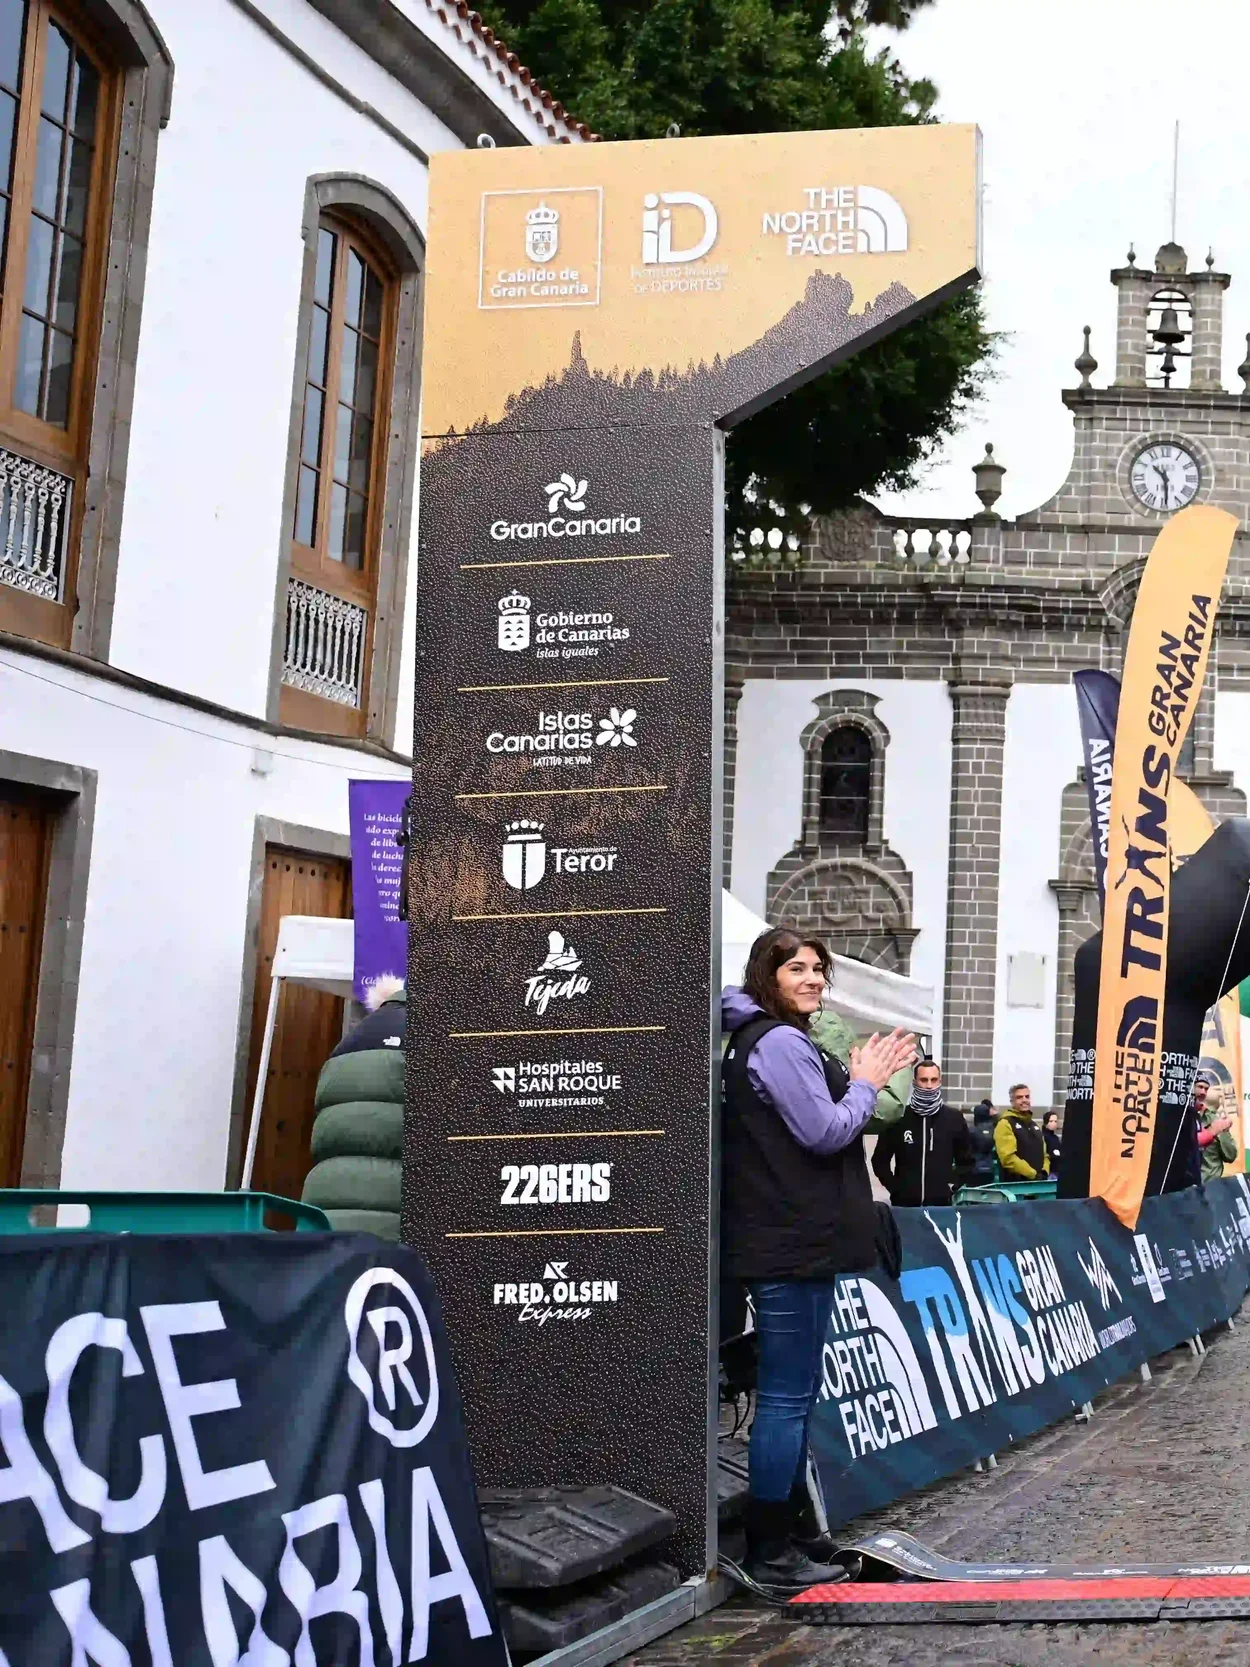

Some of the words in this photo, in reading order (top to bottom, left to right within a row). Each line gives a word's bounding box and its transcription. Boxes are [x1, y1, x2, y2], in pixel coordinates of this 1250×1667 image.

[804, 187, 855, 209] THE
[763, 209, 857, 236] NORTH
[786, 232, 857, 256] FACE
[497, 269, 556, 283] Cabildo
[561, 268, 579, 281] de
[490, 284, 527, 298] Gran
[530, 281, 589, 296] Canaria
[489, 513, 641, 541] GranCanaria
[536, 611, 613, 627] Gobierno
[536, 628, 556, 644] de
[558, 625, 630, 643] Canarias
[536, 647, 560, 659] islas
[561, 645, 599, 659] iguales
[1165, 593, 1213, 748] CANARIA
[1148, 629, 1182, 737] GRAN
[538, 711, 593, 731] Islas
[486, 729, 593, 753] Canarias
[550, 848, 618, 874] Teror
[524, 973, 591, 1015] Tejeda
[518, 1060, 604, 1077] Hospitales
[1076, 1061, 1095, 1074] THE
[1160, 1051, 1190, 1067] ORTH
[518, 1077, 554, 1093] SAN
[558, 1075, 622, 1091] ROQUE
[1135, 1057, 1155, 1134] FACE
[1166, 1078, 1187, 1092] THE
[518, 1096, 604, 1108] UNIVERSITARIOS
[1120, 1051, 1141, 1159] NORTH
[500, 1162, 612, 1205] 226ERS
[1015, 1245, 1066, 1312] GRAN
[518, 1302, 593, 1327] Express
[1036, 1300, 1101, 1377] CANARIA
[838, 1388, 904, 1460] FACE
